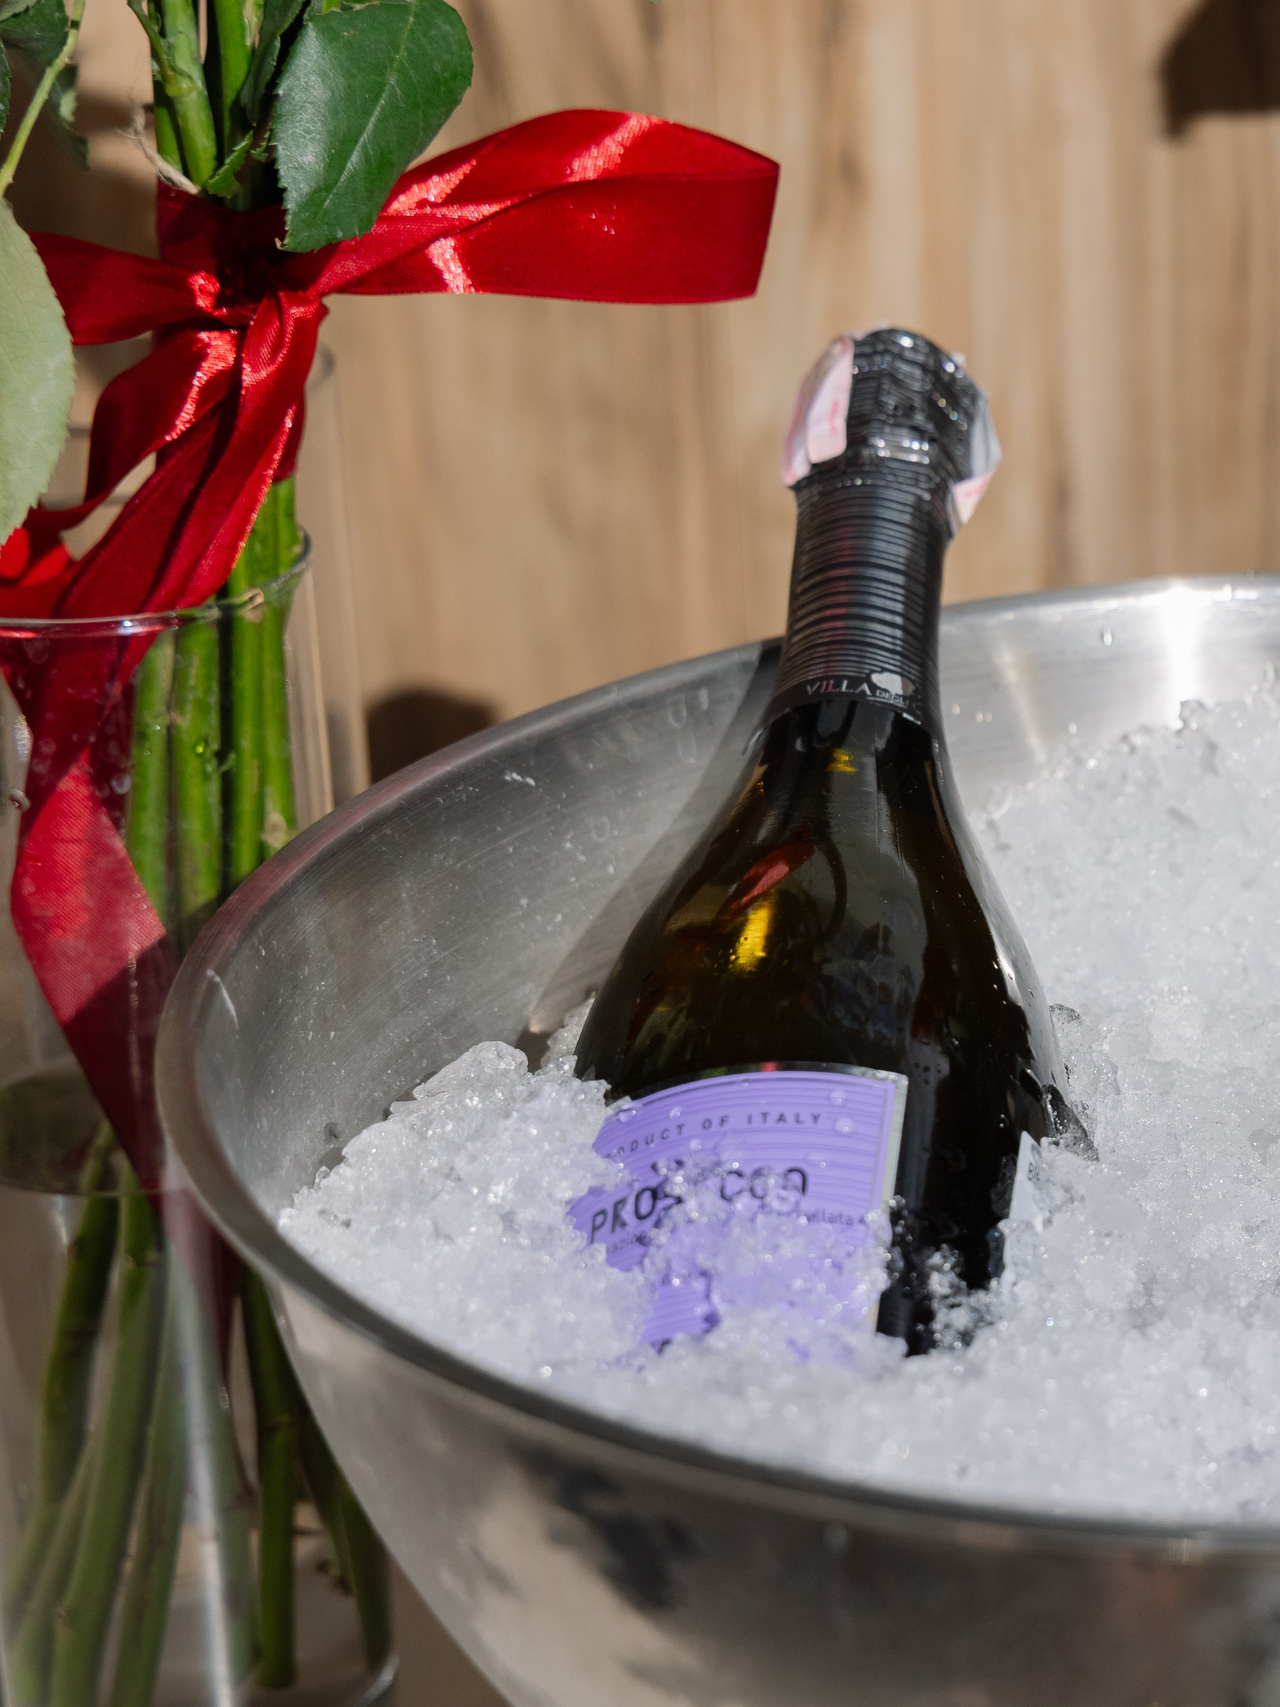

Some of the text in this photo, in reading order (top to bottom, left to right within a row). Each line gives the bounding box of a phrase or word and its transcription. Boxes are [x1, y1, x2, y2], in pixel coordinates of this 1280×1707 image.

[806, 679, 872, 696] VILLA
[701, 1115, 730, 1131] OF
[747, 1111, 821, 1126] ITALY
[590, 1165, 809, 1245] PROSCCO
